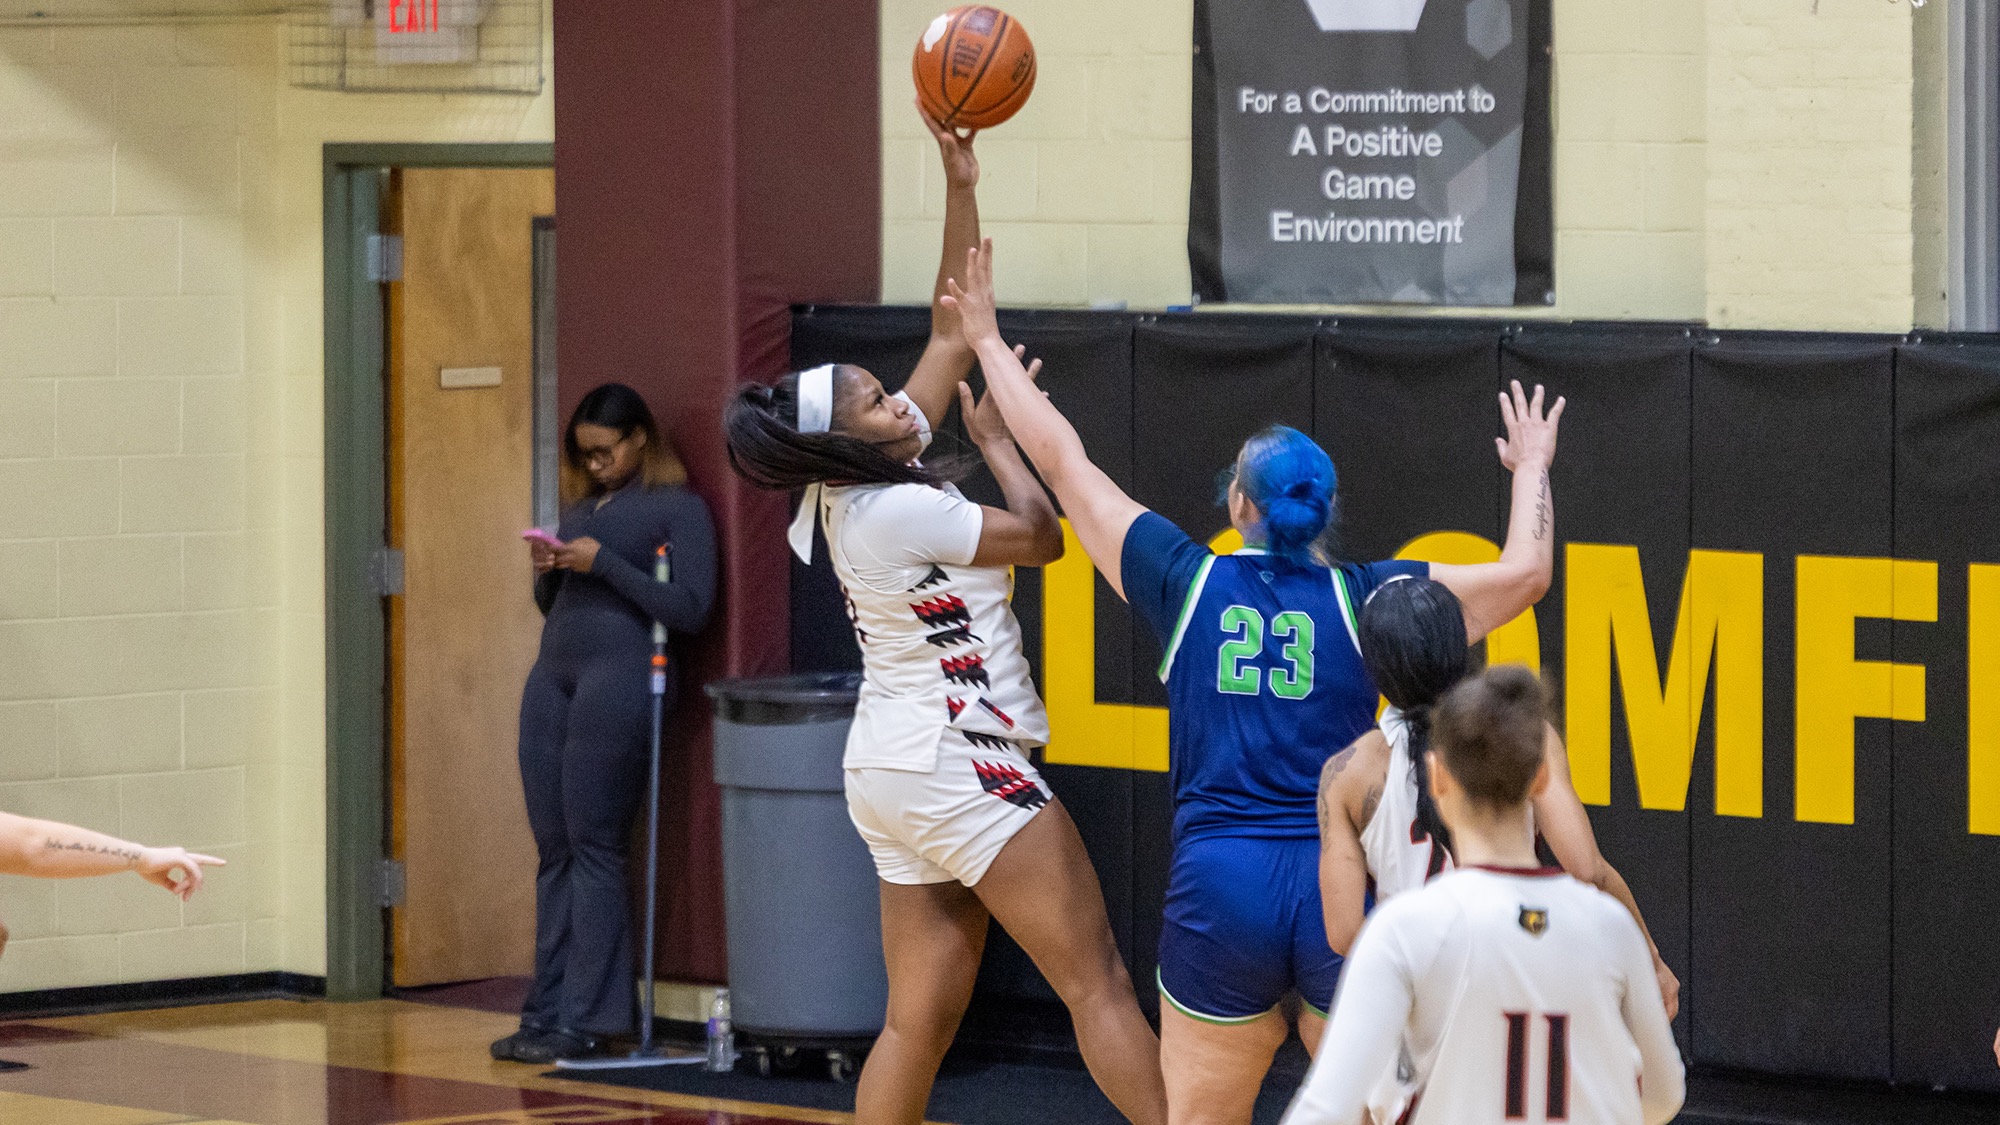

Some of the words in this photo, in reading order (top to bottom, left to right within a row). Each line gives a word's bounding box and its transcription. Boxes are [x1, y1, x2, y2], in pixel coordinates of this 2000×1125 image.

[1241, 89, 1277, 113] For
[1285, 95, 1302, 113] a
[1310, 87, 1466, 113] Commitment
[1472, 90, 1496, 113] to
[1292, 127, 1318, 156] A
[1327, 126, 1443, 157] Positive
[1324, 169, 1416, 200] Game
[1273, 212, 1464, 243] Environment
[1217, 604, 1315, 700] 23
[1503, 1012, 1569, 1121] 11
